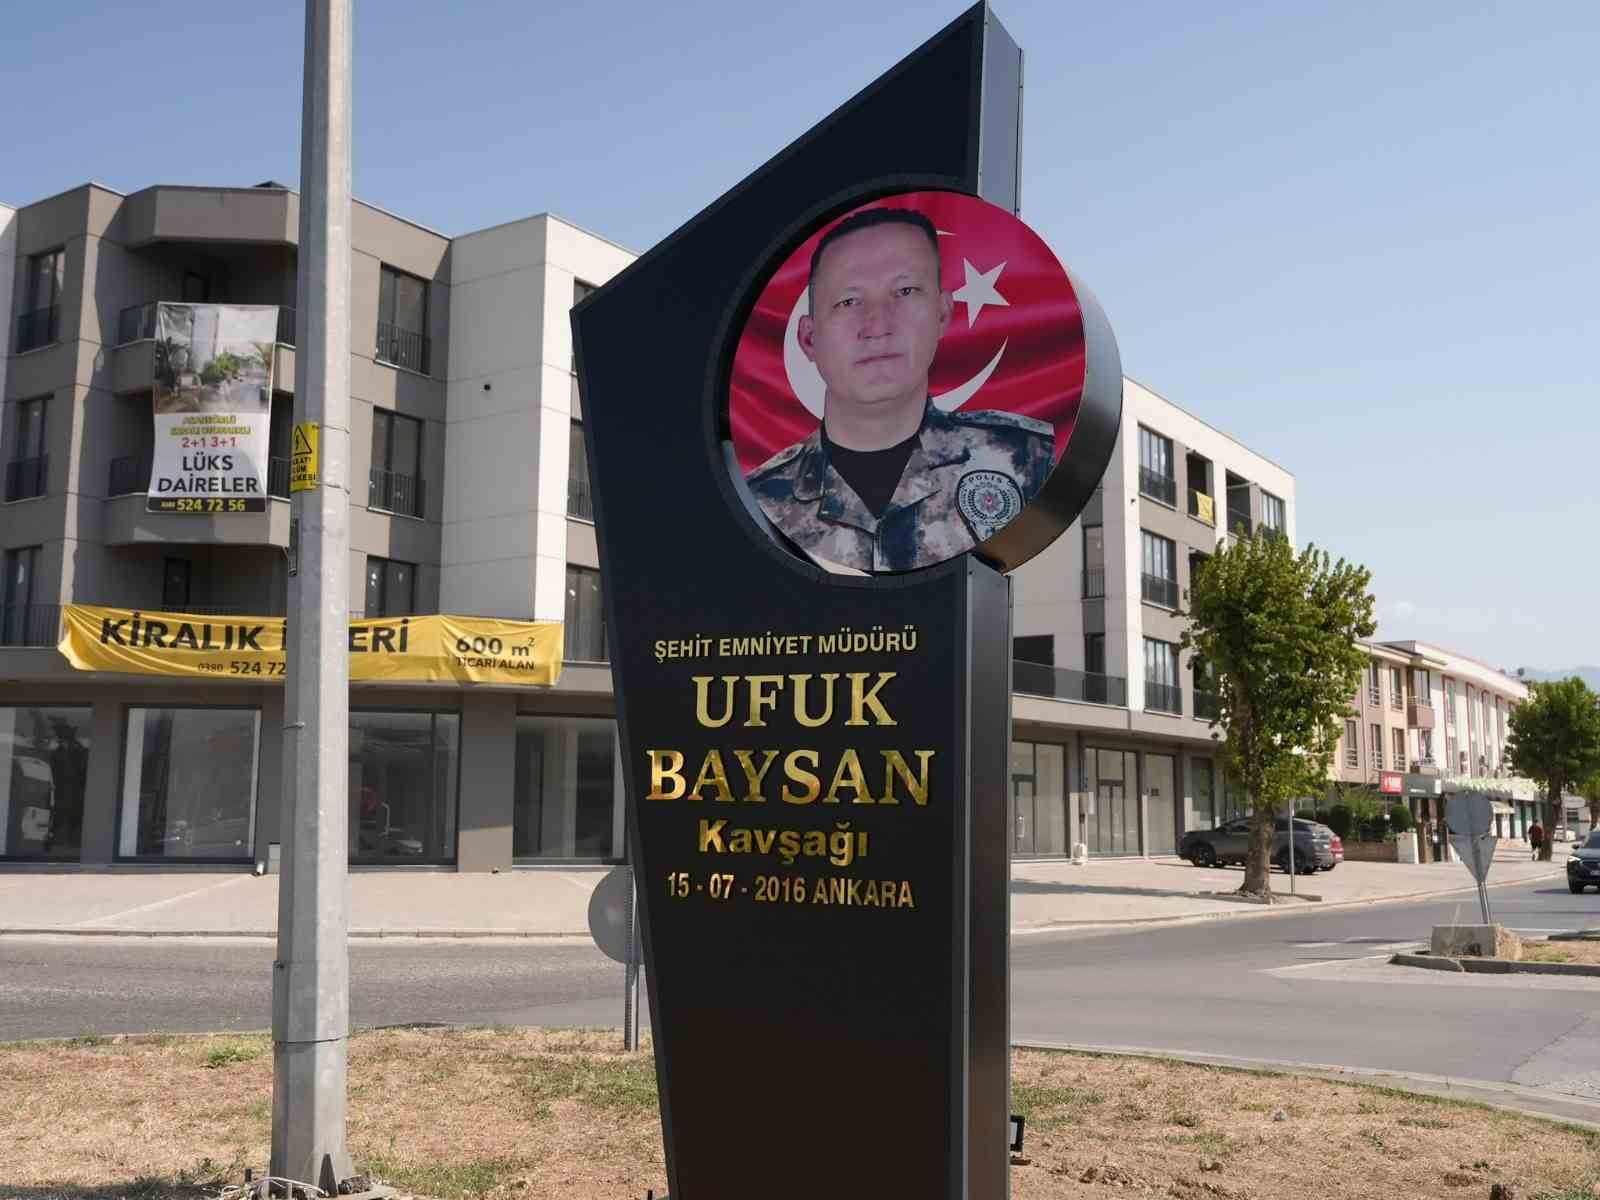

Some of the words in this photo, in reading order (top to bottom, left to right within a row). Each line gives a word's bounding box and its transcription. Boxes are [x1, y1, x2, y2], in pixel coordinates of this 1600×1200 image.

[181, 437, 206, 448] 2+1
[210, 436, 236, 448] 3+1
[182, 451, 234, 471] LÜKS
[157, 473, 258, 492] DAİRELER
[176, 499, 202, 512] 524
[207, 499, 225, 512] 72
[228, 499, 246, 512] 56
[100, 612, 265, 651] KİRALIK
[456, 636, 503, 655] 600
[655, 633, 713, 664] ŞEHİT
[719, 631, 812, 657] EMNİYET
[818, 624, 918, 654] MÜDÜRÜ
[230, 660, 262, 675] 524
[267, 661, 286, 675] 72
[498, 658, 535, 671] ALAN
[691, 672, 898, 728] UFUK
[646, 749, 936, 806] BAYSAN
[699, 819, 869, 867] Kavşağı
[668, 872, 689, 898] 15
[709, 873, 735, 899] 07
[754, 876, 806, 904] 2016
[812, 877, 915, 909] ANKARA
